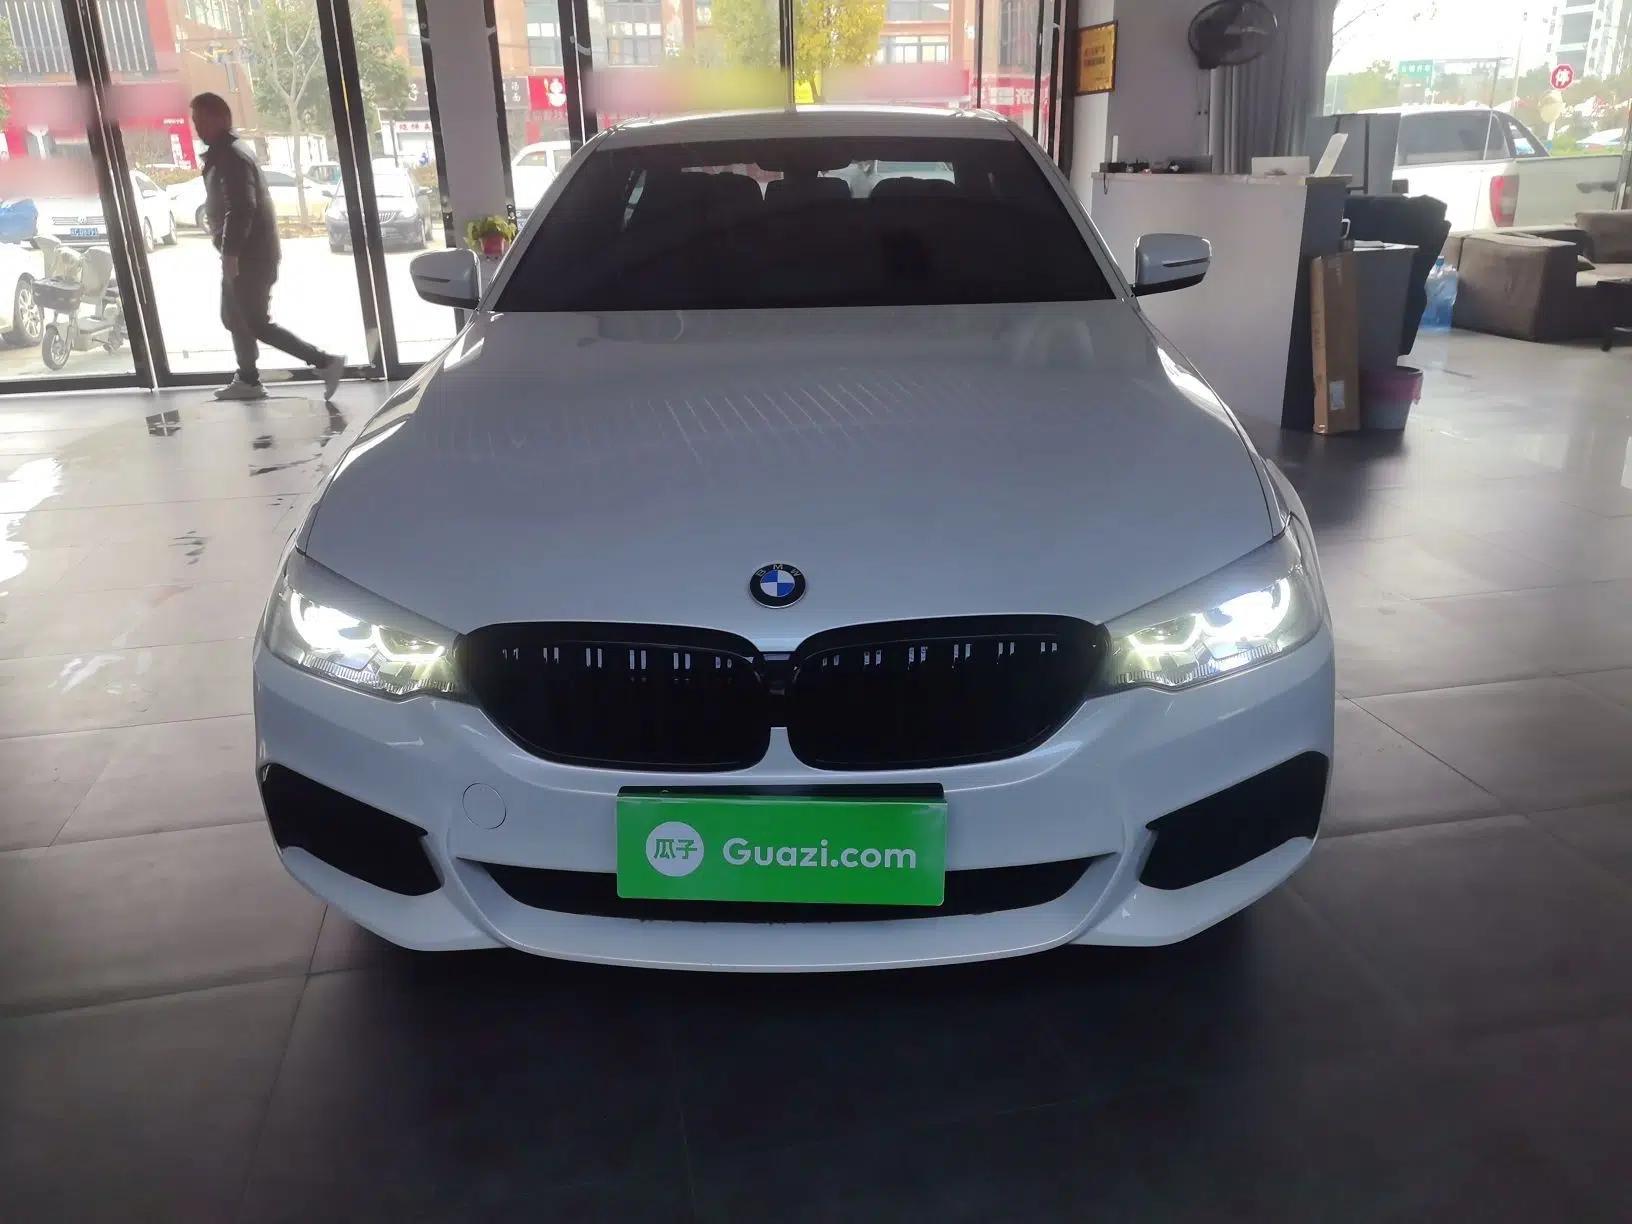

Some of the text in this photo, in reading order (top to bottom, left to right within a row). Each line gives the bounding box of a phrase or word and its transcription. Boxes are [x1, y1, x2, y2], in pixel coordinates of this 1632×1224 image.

[755, 564, 802, 577] BMW
[653, 837, 917, 868] 瓜子 Guazi.com
